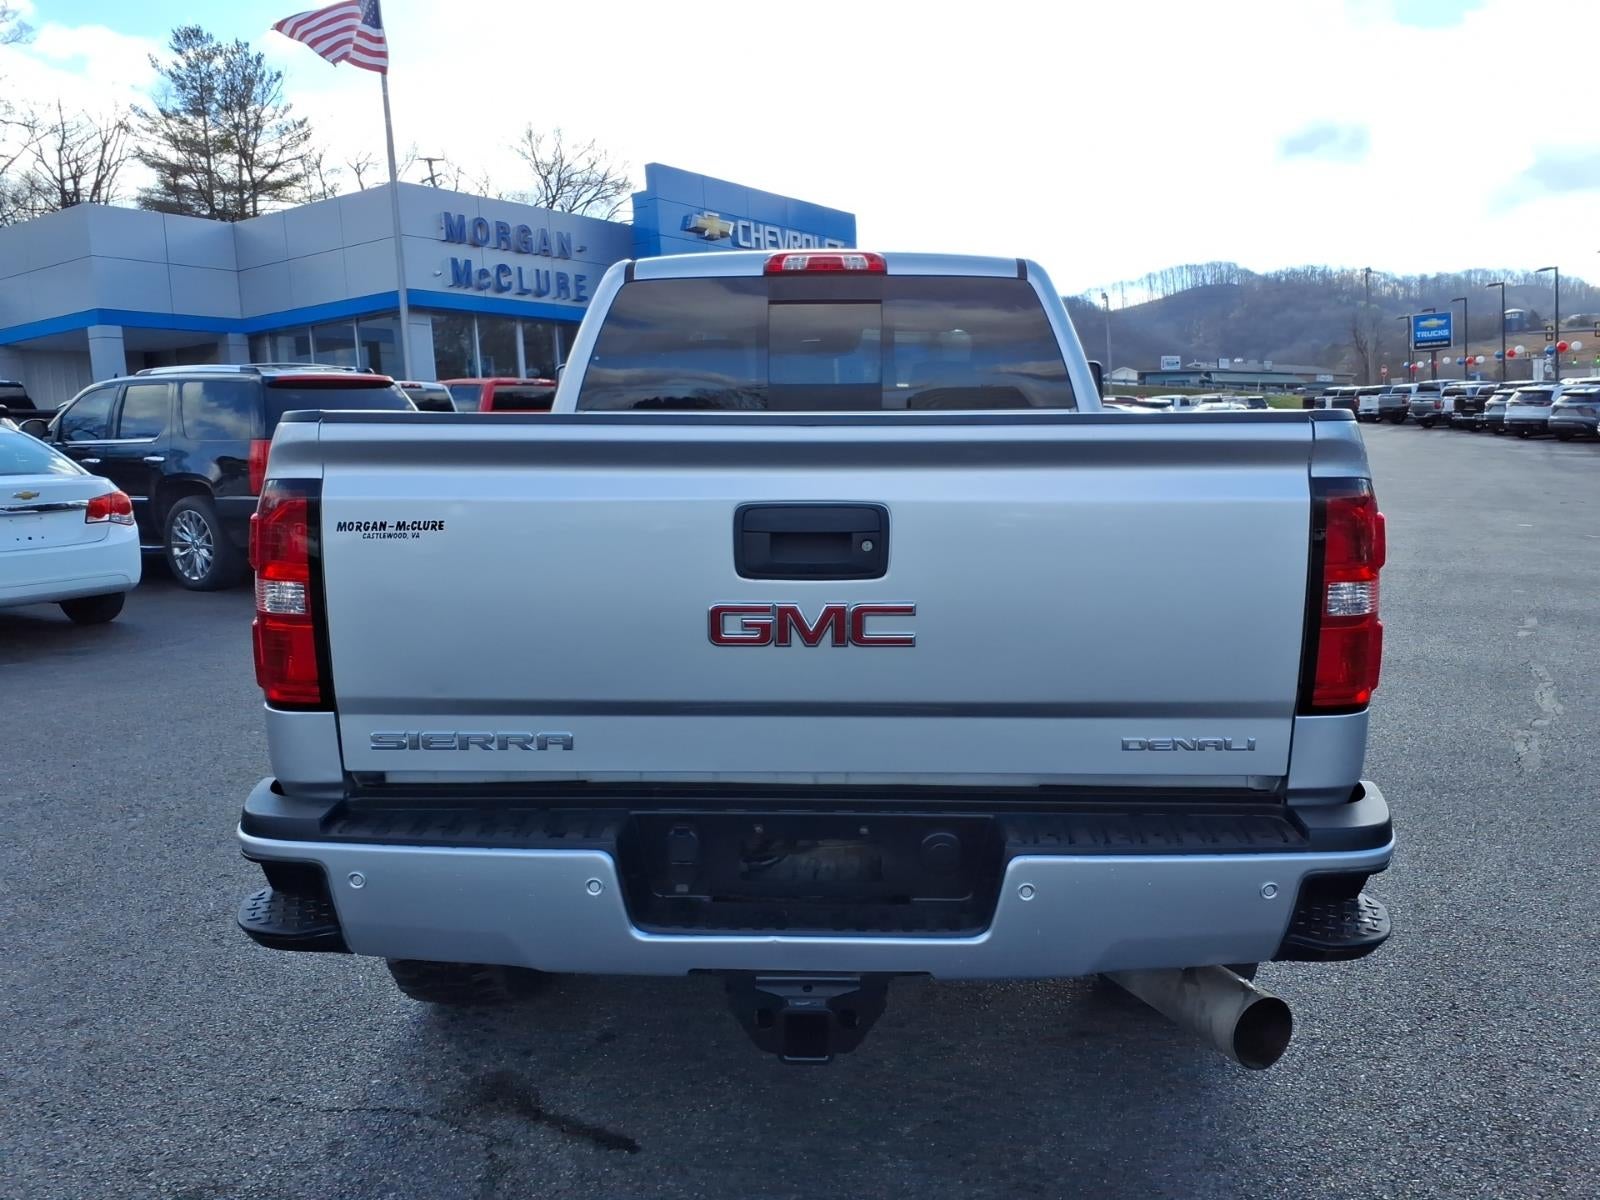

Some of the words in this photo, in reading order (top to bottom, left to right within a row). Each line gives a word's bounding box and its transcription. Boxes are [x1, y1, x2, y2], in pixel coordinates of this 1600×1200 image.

[737, 220, 845, 250] CHEVROL
[450, 257, 588, 302] McCLURE
[1416, 329, 1449, 338] TRUCKS
[362, 532, 409, 540] CASTLEWOOD,
[708, 603, 916, 647] GMC
[369, 731, 574, 751] SIERRA
[1120, 736, 1256, 751] DENALI
